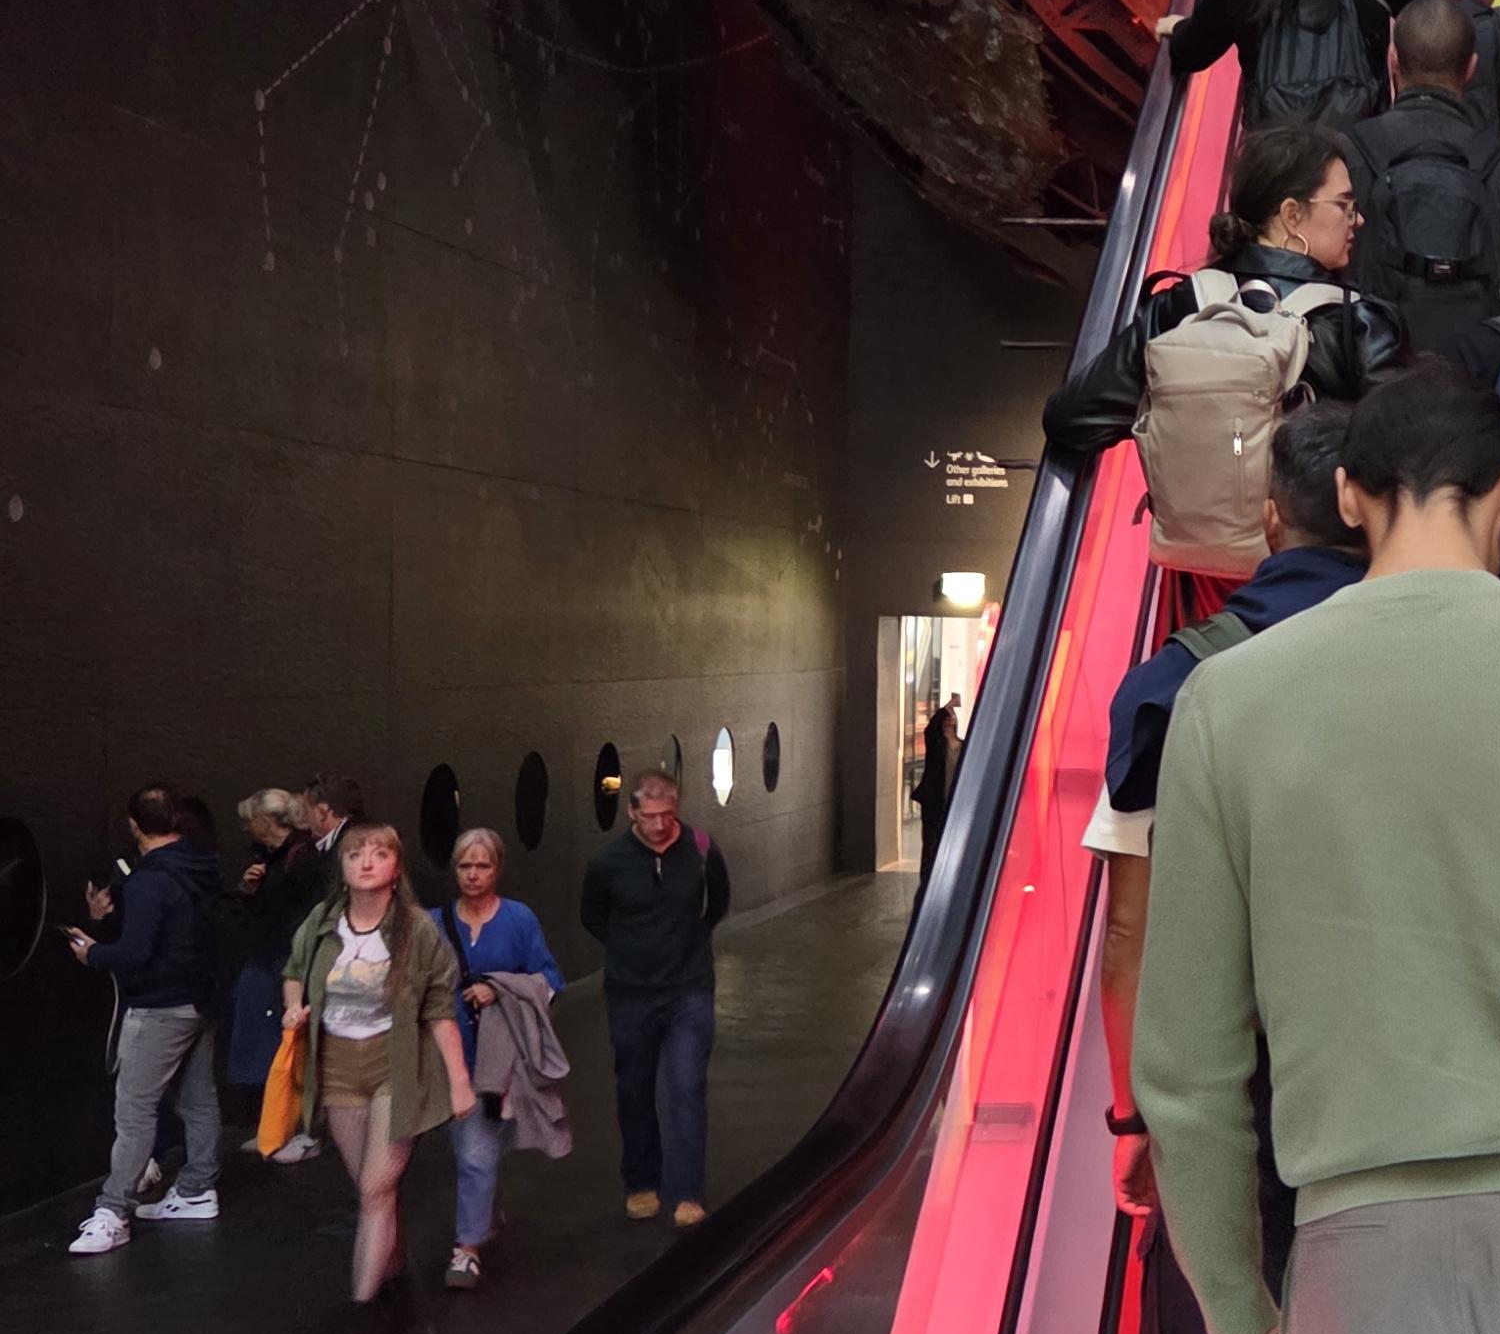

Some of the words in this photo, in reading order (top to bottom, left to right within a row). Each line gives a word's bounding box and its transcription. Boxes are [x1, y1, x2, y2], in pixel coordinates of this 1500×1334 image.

[946, 464, 970, 475] Other
[971, 465, 1006, 477] galleries
[946, 477, 963, 487] and
[964, 477, 1009, 487] exhibitions
[946, 494, 961, 505] Lift
